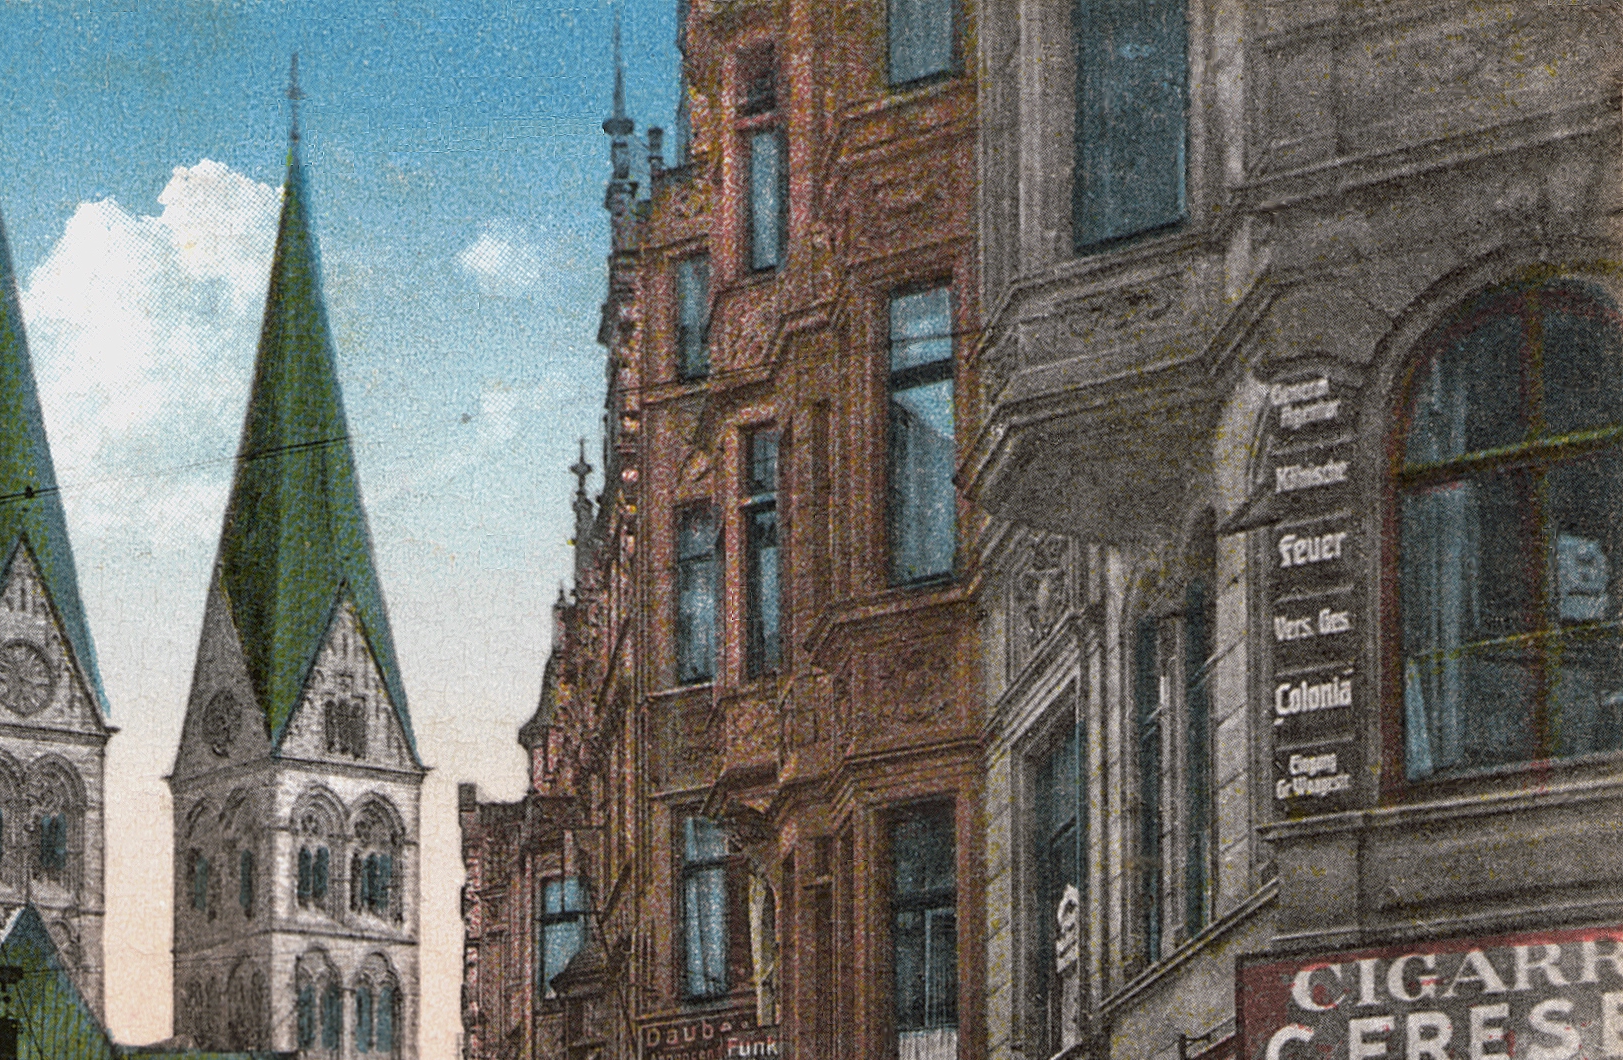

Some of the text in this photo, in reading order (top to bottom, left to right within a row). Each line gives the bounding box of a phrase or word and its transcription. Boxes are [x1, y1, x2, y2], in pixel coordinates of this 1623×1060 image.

[1279, 532, 1348, 568] Feuer
[1275, 676, 1352, 716] Colonia
[728, 1034, 778, 1057] Funk
